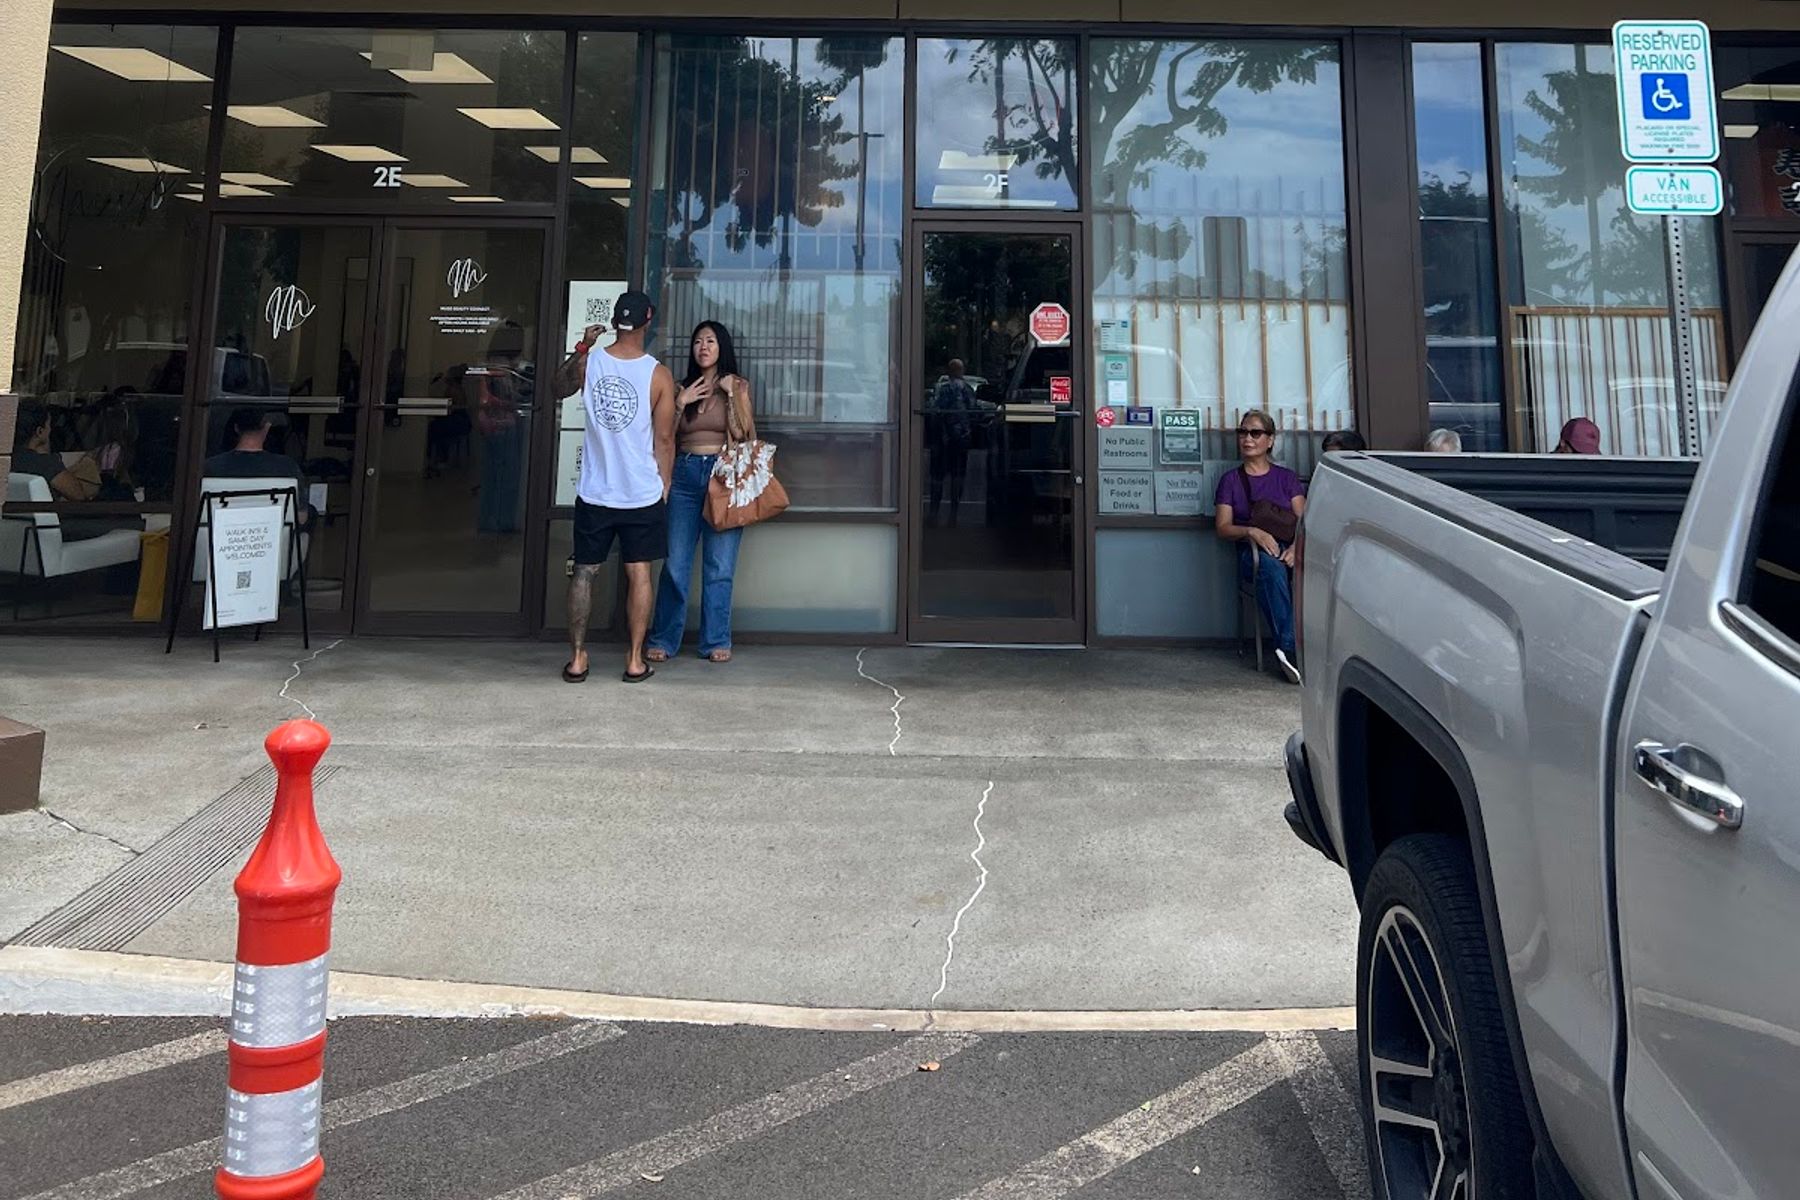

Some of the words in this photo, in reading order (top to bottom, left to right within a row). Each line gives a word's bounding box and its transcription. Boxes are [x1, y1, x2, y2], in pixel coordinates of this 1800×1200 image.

[1621, 33, 1701, 51] RESERVED
[1630, 53, 1697, 71] PARKING
[373, 166, 402, 187] 2E
[983, 173, 1009, 193] 2F
[1656, 176, 1690, 191] VAN
[1643, 193, 1708, 204] ACCESSIBLE
[1052, 393, 1069, 401] PULL
[1165, 415, 1195, 426] PASS
[1119, 437, 1145, 446] Public
[1103, 449, 1148, 458] Restrooms
[1103, 477, 1115, 485] No
[1116, 476, 1149, 486] Outside
[1166, 479, 1179, 488] No
[1180, 479, 1198, 488] Pets
[1110, 489, 1132, 498] Food
[1133, 490, 1142, 498] or
[1112, 501, 1140, 510] Drinks
[225, 527, 247, 537] WALK
[228, 535, 249, 544] SAME
[250, 535, 265, 543] DAY
[219, 542, 272, 552] APPOINTMENTS
